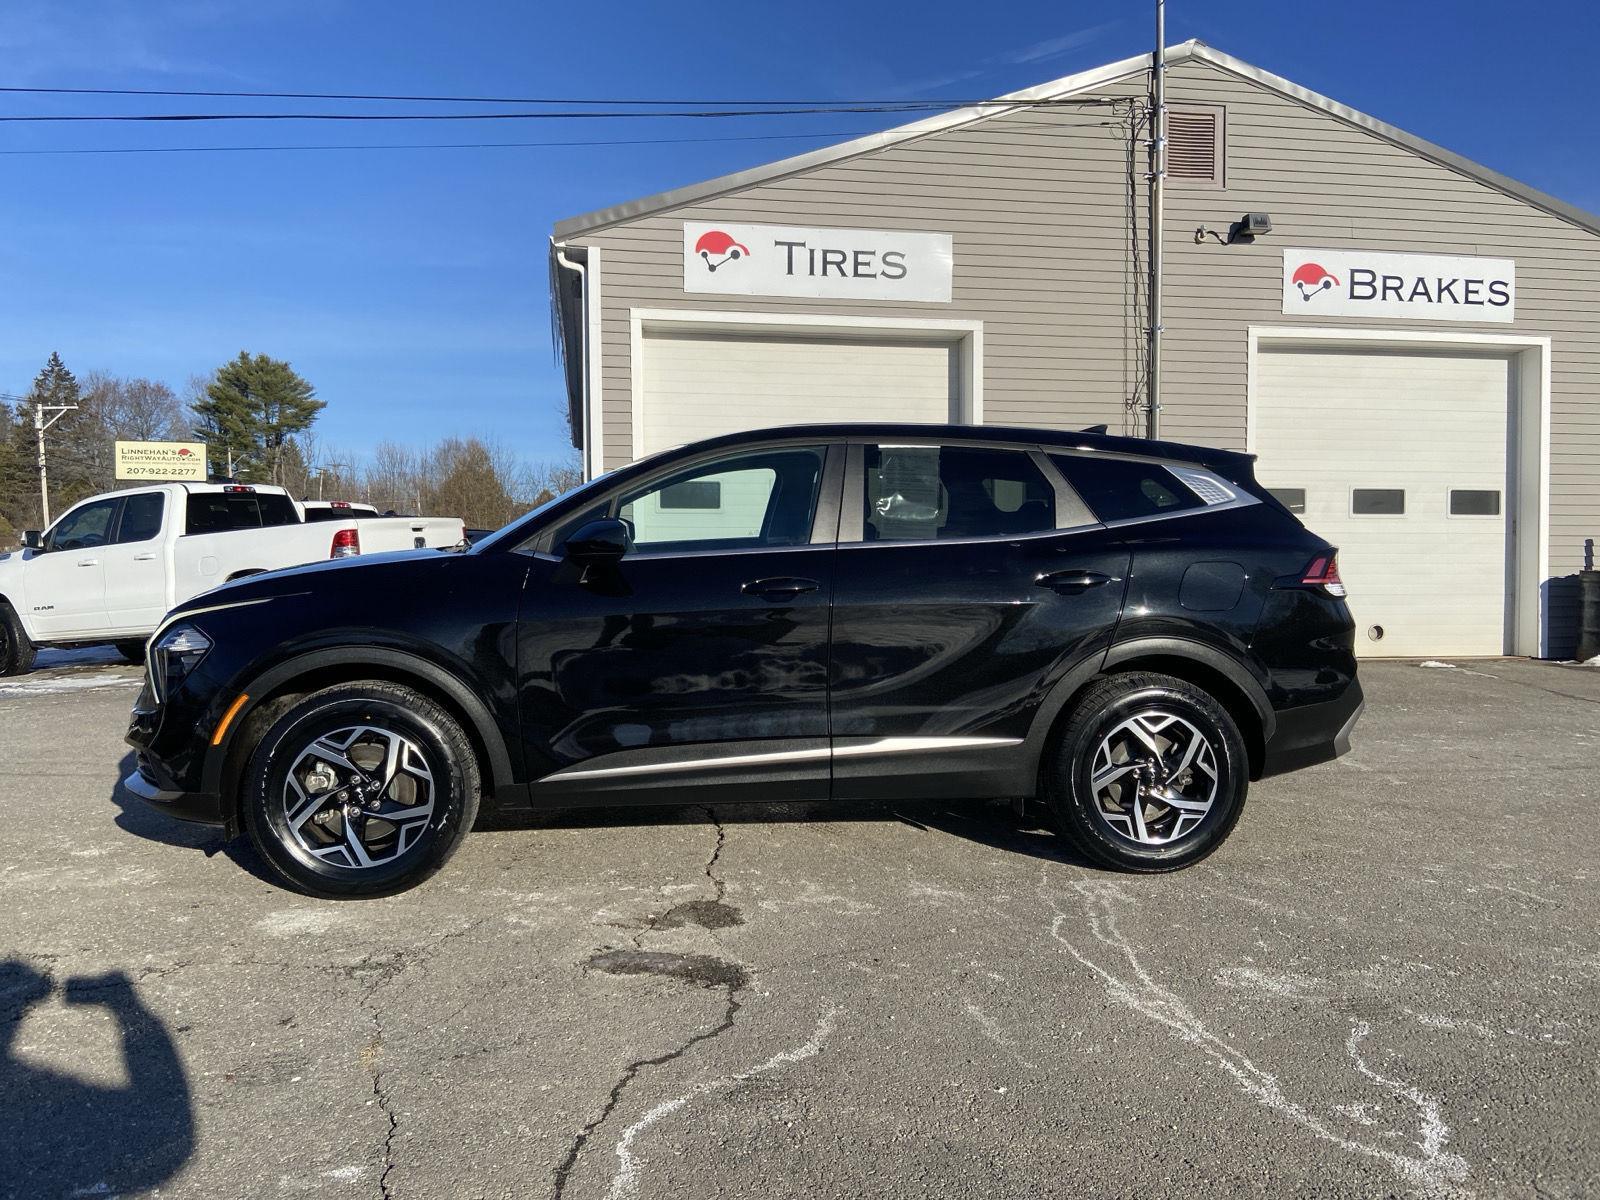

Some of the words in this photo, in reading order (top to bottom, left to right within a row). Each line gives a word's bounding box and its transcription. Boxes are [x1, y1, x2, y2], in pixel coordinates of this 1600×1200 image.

[774, 240, 907, 280] TIRES
[1348, 268, 1510, 307] BRAKES
[126, 467, 196, 475] 207-922-2277
